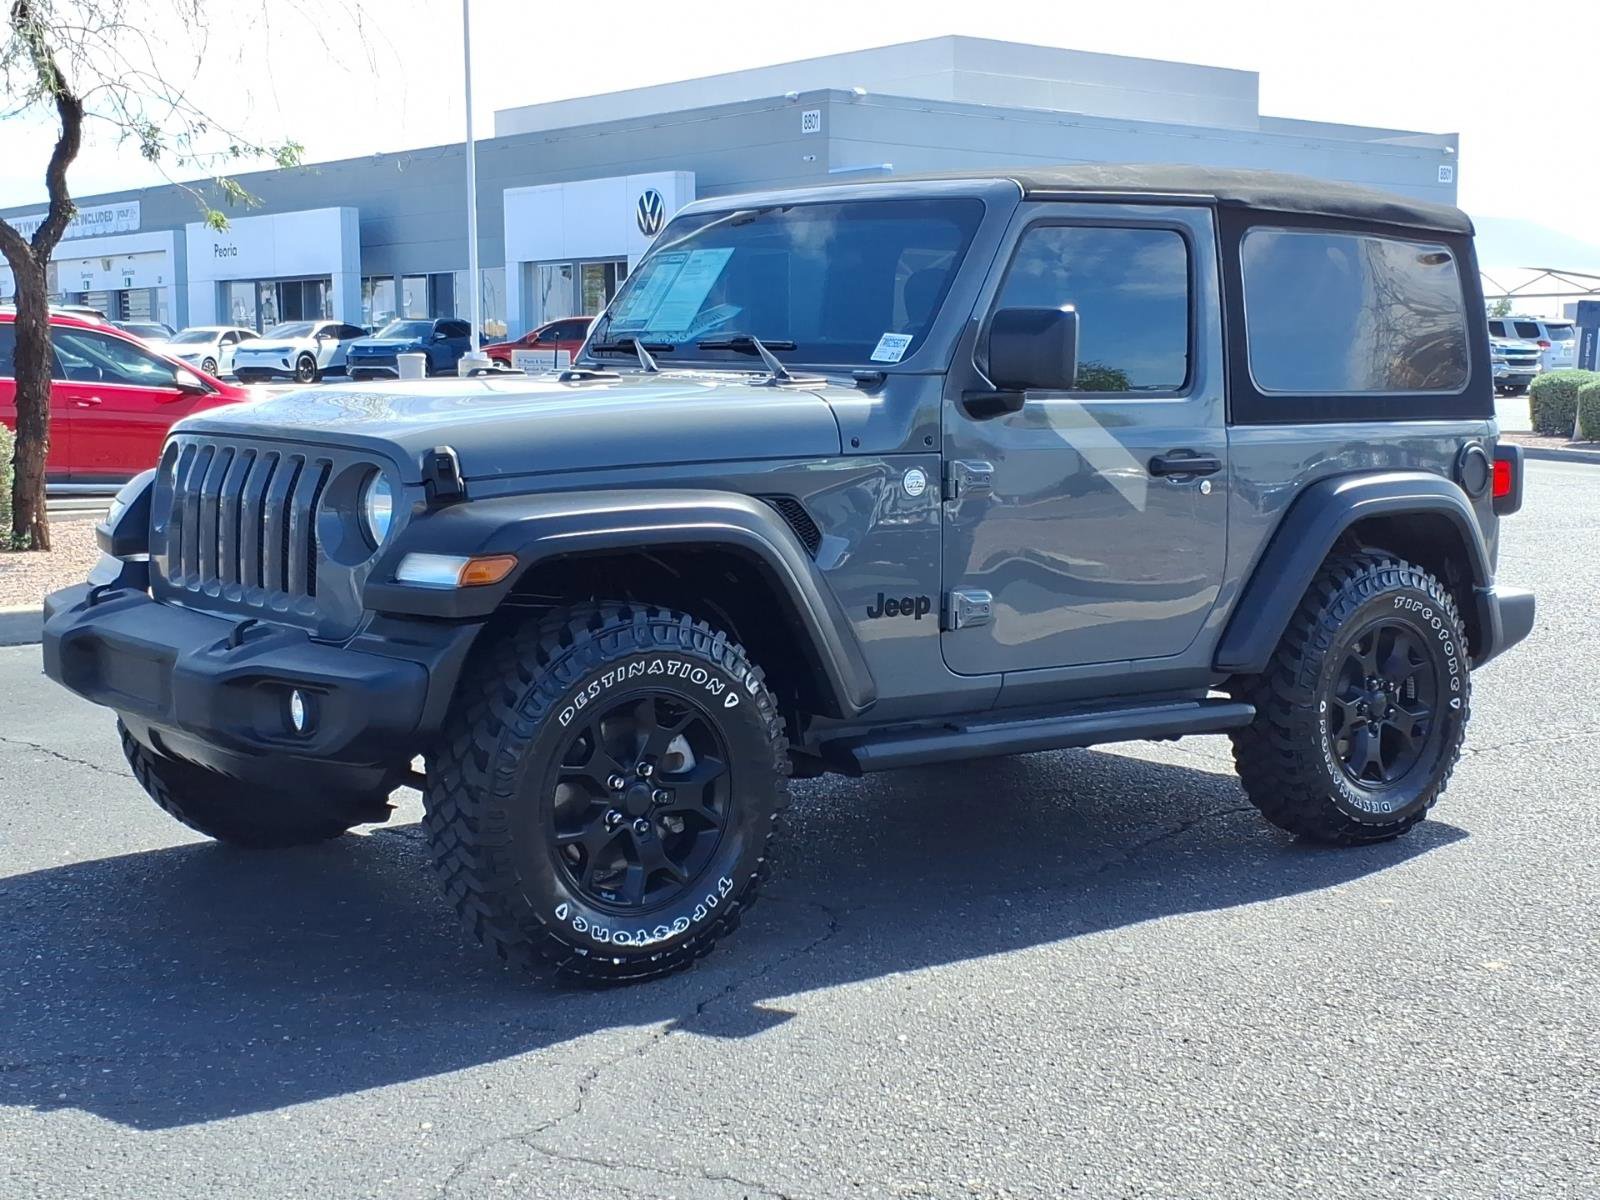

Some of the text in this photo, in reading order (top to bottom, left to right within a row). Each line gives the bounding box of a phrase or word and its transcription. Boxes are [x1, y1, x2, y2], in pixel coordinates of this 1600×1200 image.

[804, 113, 818, 130] 8801
[80, 210, 114, 226] INCLUDED
[214, 243, 238, 258] Peoria
[866, 592, 931, 620] Jeep
[1394, 596, 1460, 691] Firestone
[558, 659, 726, 727] DESTINATION
[572, 877, 733, 946] Firestone
